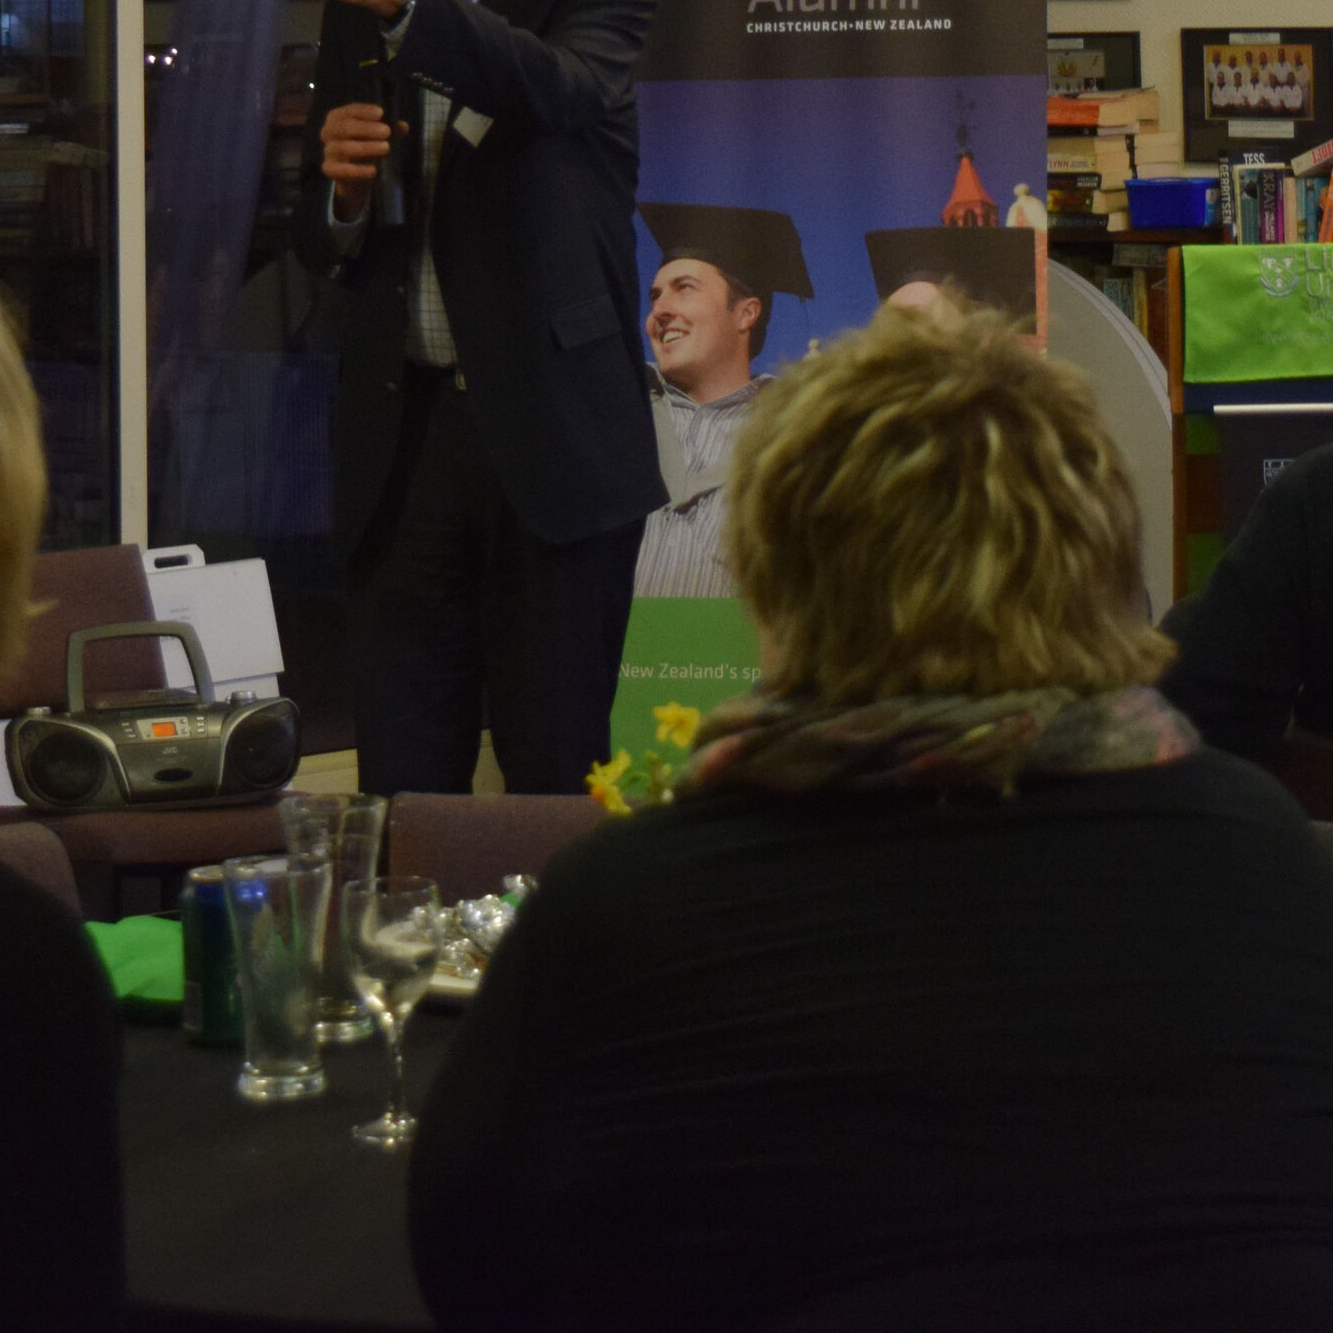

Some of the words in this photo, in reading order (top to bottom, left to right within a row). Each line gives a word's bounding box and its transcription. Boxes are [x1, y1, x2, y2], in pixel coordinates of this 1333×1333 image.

[890, 18, 952, 30] ZEALAND
[1243, 152, 1266, 165] TESS
[1219, 164, 1232, 224] GERRITSEN
[618, 663, 654, 678] New
[659, 662, 737, 679] Zealand's
